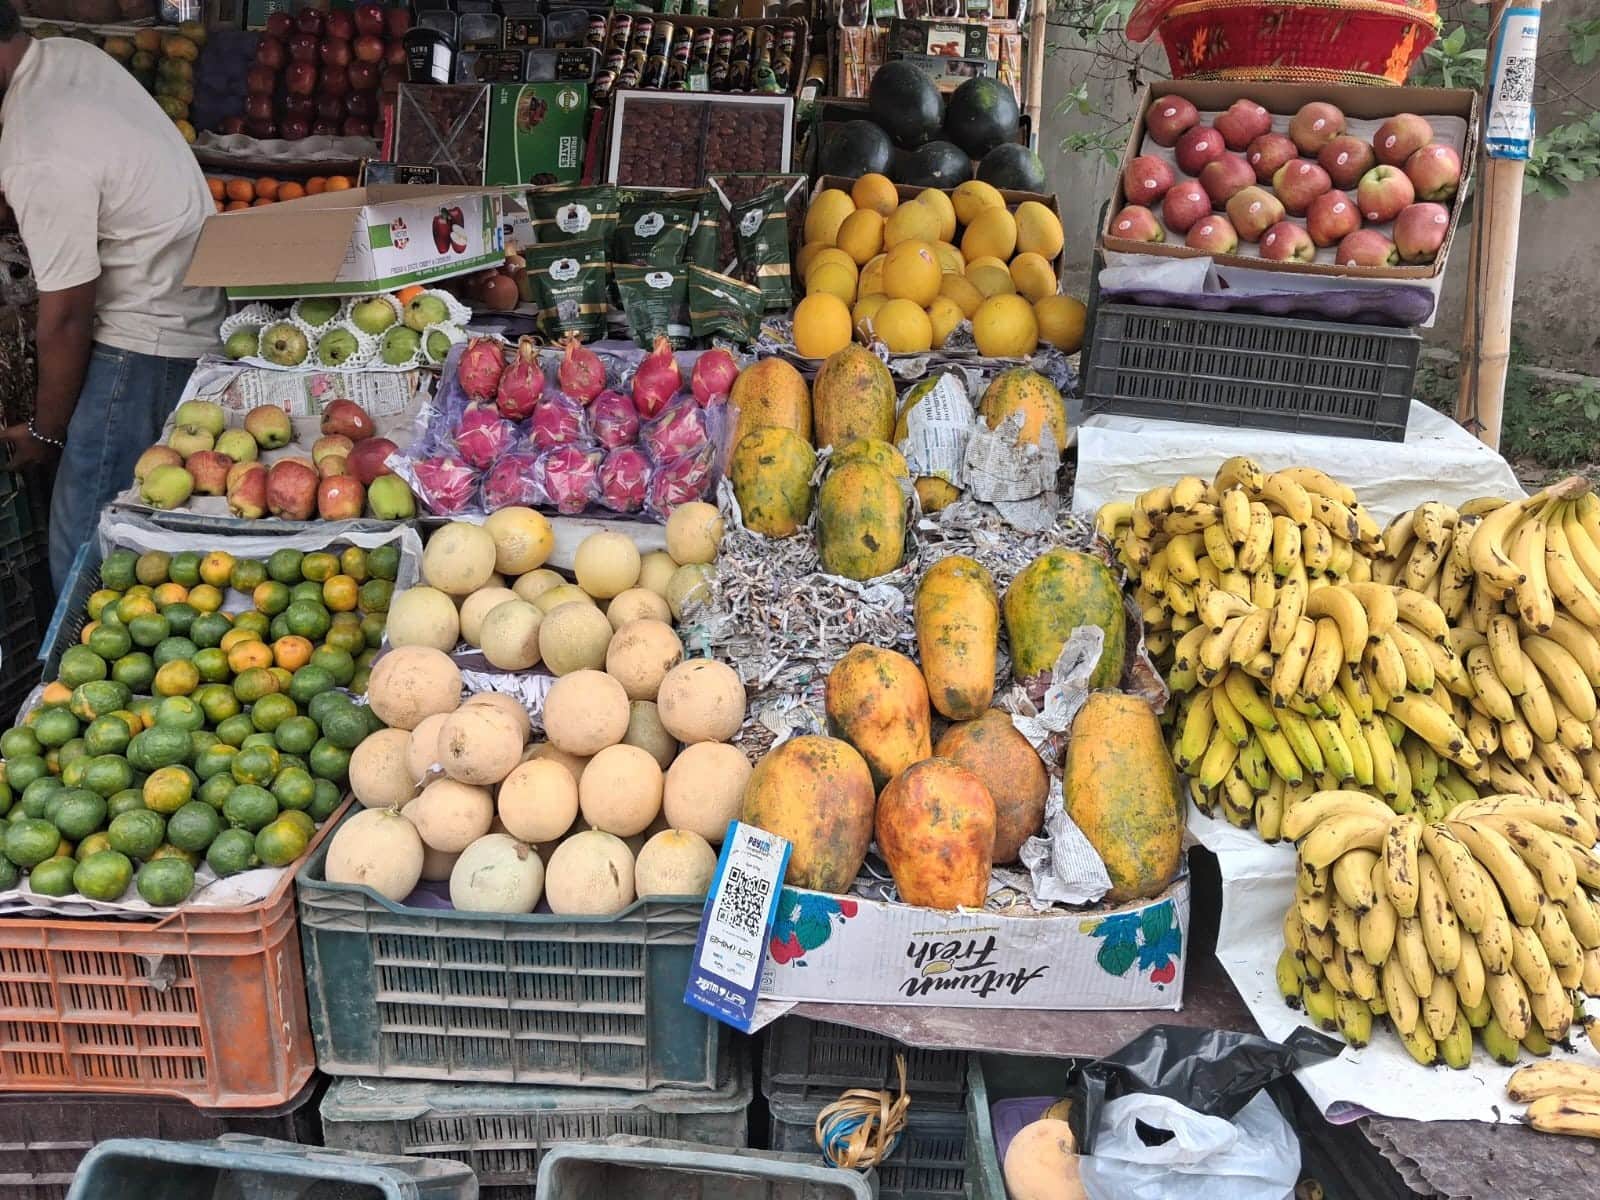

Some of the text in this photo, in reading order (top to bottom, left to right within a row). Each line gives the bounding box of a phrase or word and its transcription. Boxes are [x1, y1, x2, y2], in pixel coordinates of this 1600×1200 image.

[560, 137, 570, 167] DATES
[906, 935, 999, 972] Fresh
[898, 965, 1050, 998] Autumn
